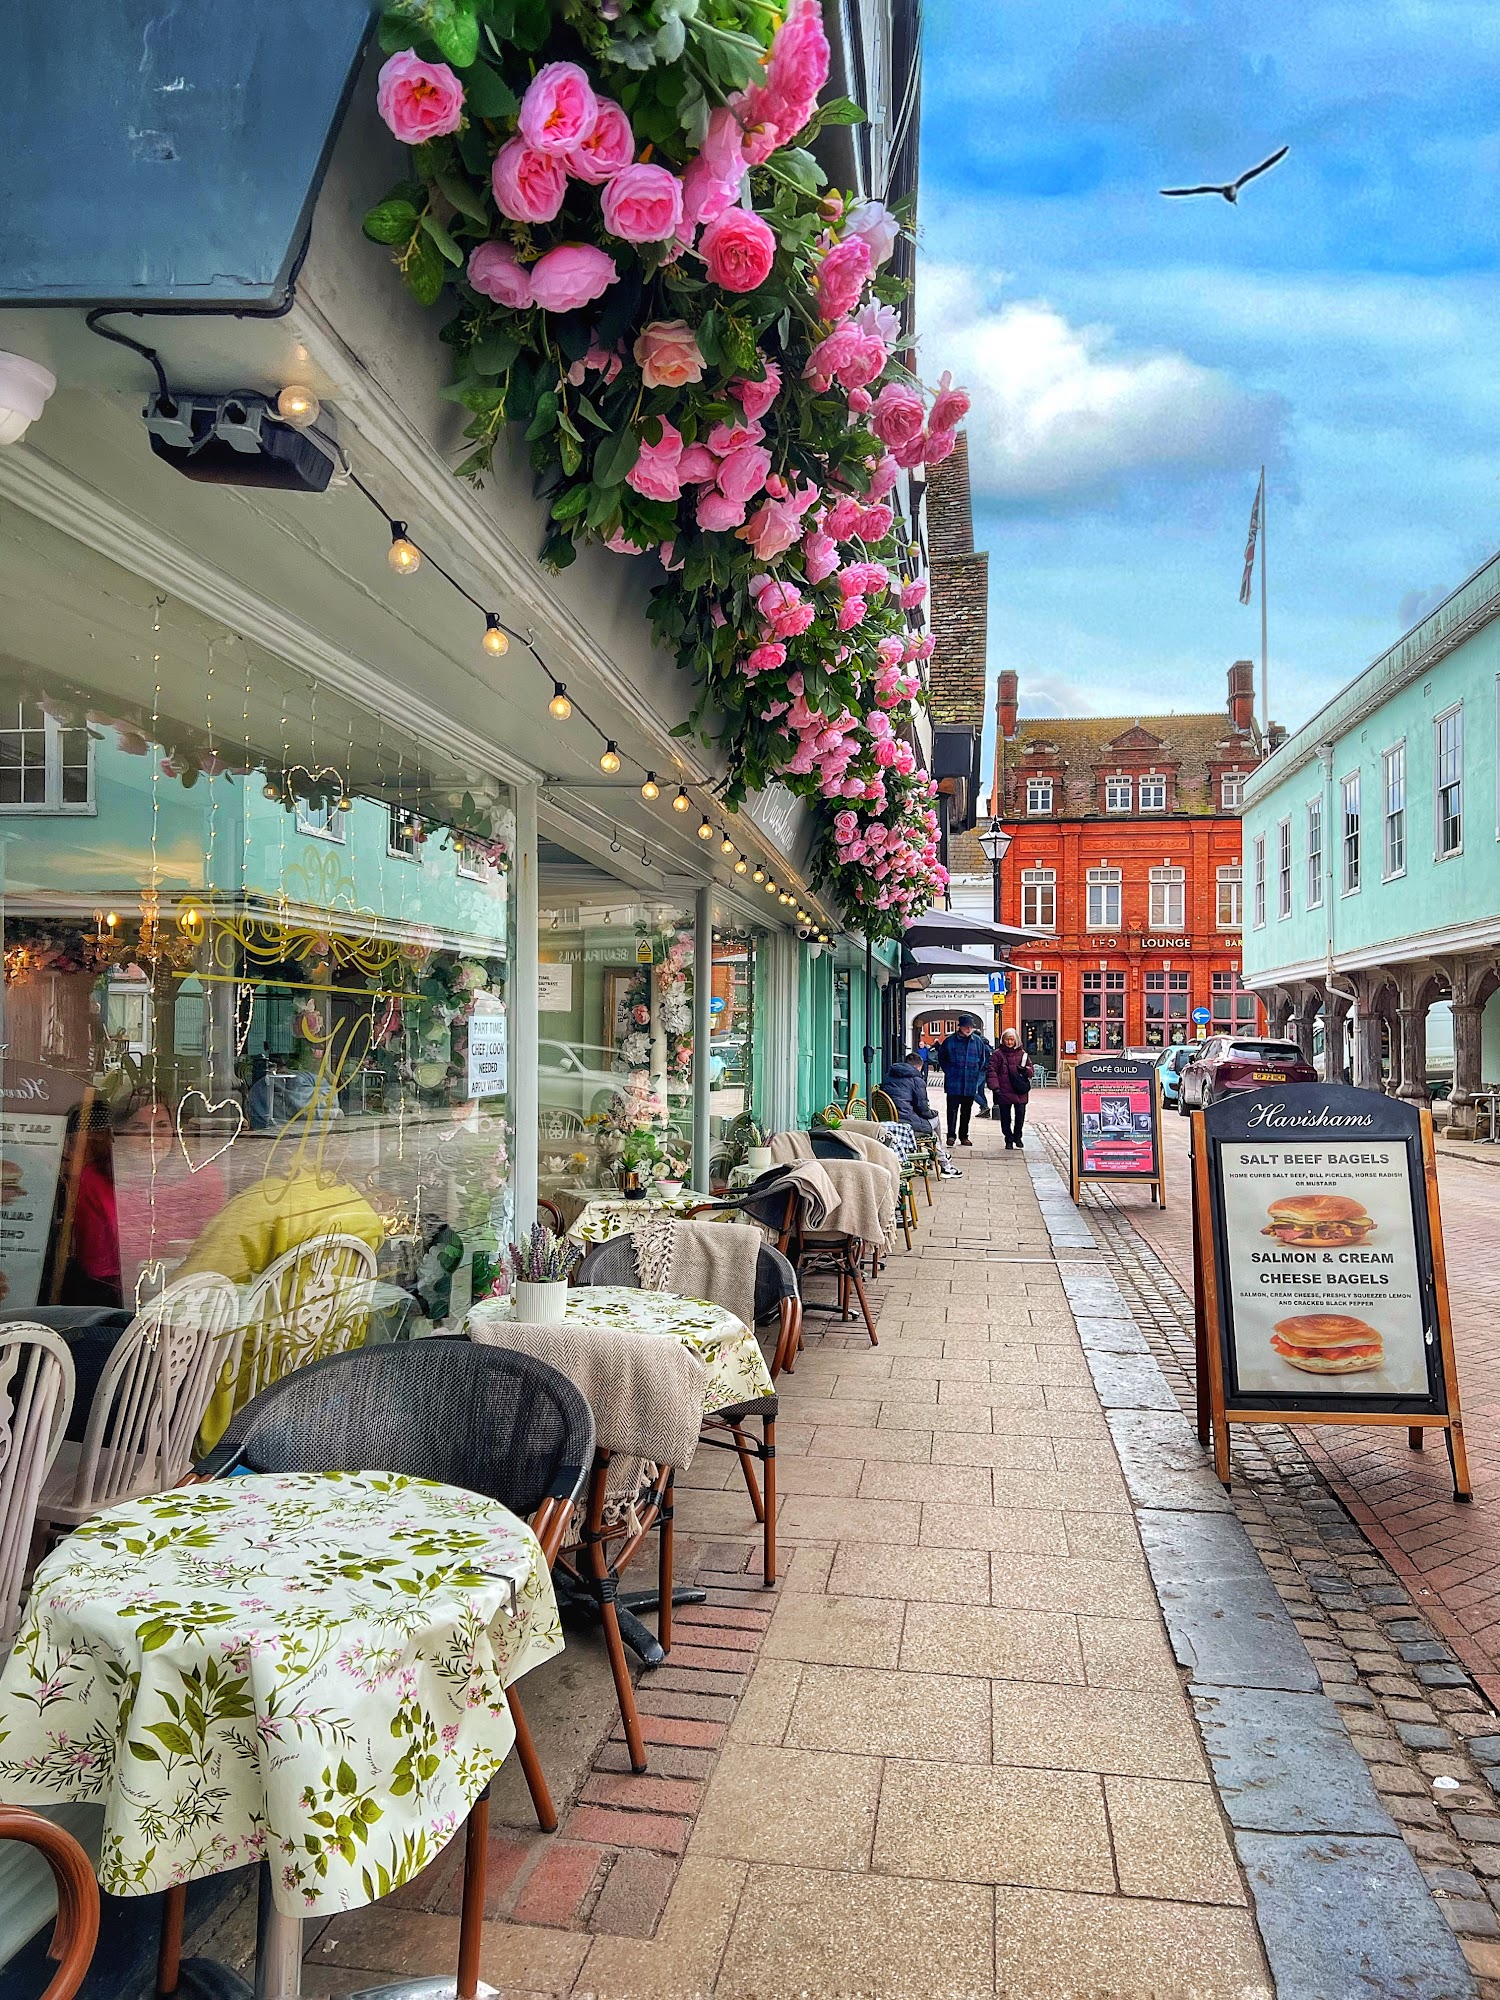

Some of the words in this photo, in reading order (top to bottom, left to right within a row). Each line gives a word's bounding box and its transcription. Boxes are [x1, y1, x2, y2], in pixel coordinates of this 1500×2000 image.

[1141, 938, 1191, 948] LOUNGE
[474, 1022, 489, 1035] PART
[490, 1022, 503, 1035] TIME
[471, 1043, 486, 1056] CHEF
[489, 1042, 505, 1055] COOK
[478, 1062, 498, 1074] NEEDED
[1091, 1064, 1113, 1073] CAFÉ
[1113, 1066, 1138, 1074] GUILD
[471, 1081, 487, 1094] APPLY
[487, 1079, 505, 1091] WITHIN
[1247, 1103, 1374, 1128] Havishams
[1239, 1154, 1279, 1165] SALT
[1283, 1154, 1323, 1165] BEEF
[1327, 1153, 1390, 1164] BAGELS
[1251, 1252, 1317, 1263] SALMON
[1322, 1253, 1334, 1263] &
[1338, 1253, 1394, 1264] CREAM
[1259, 1273, 1322, 1284] CHEESE
[1326, 1273, 1389, 1285] BAGELS
